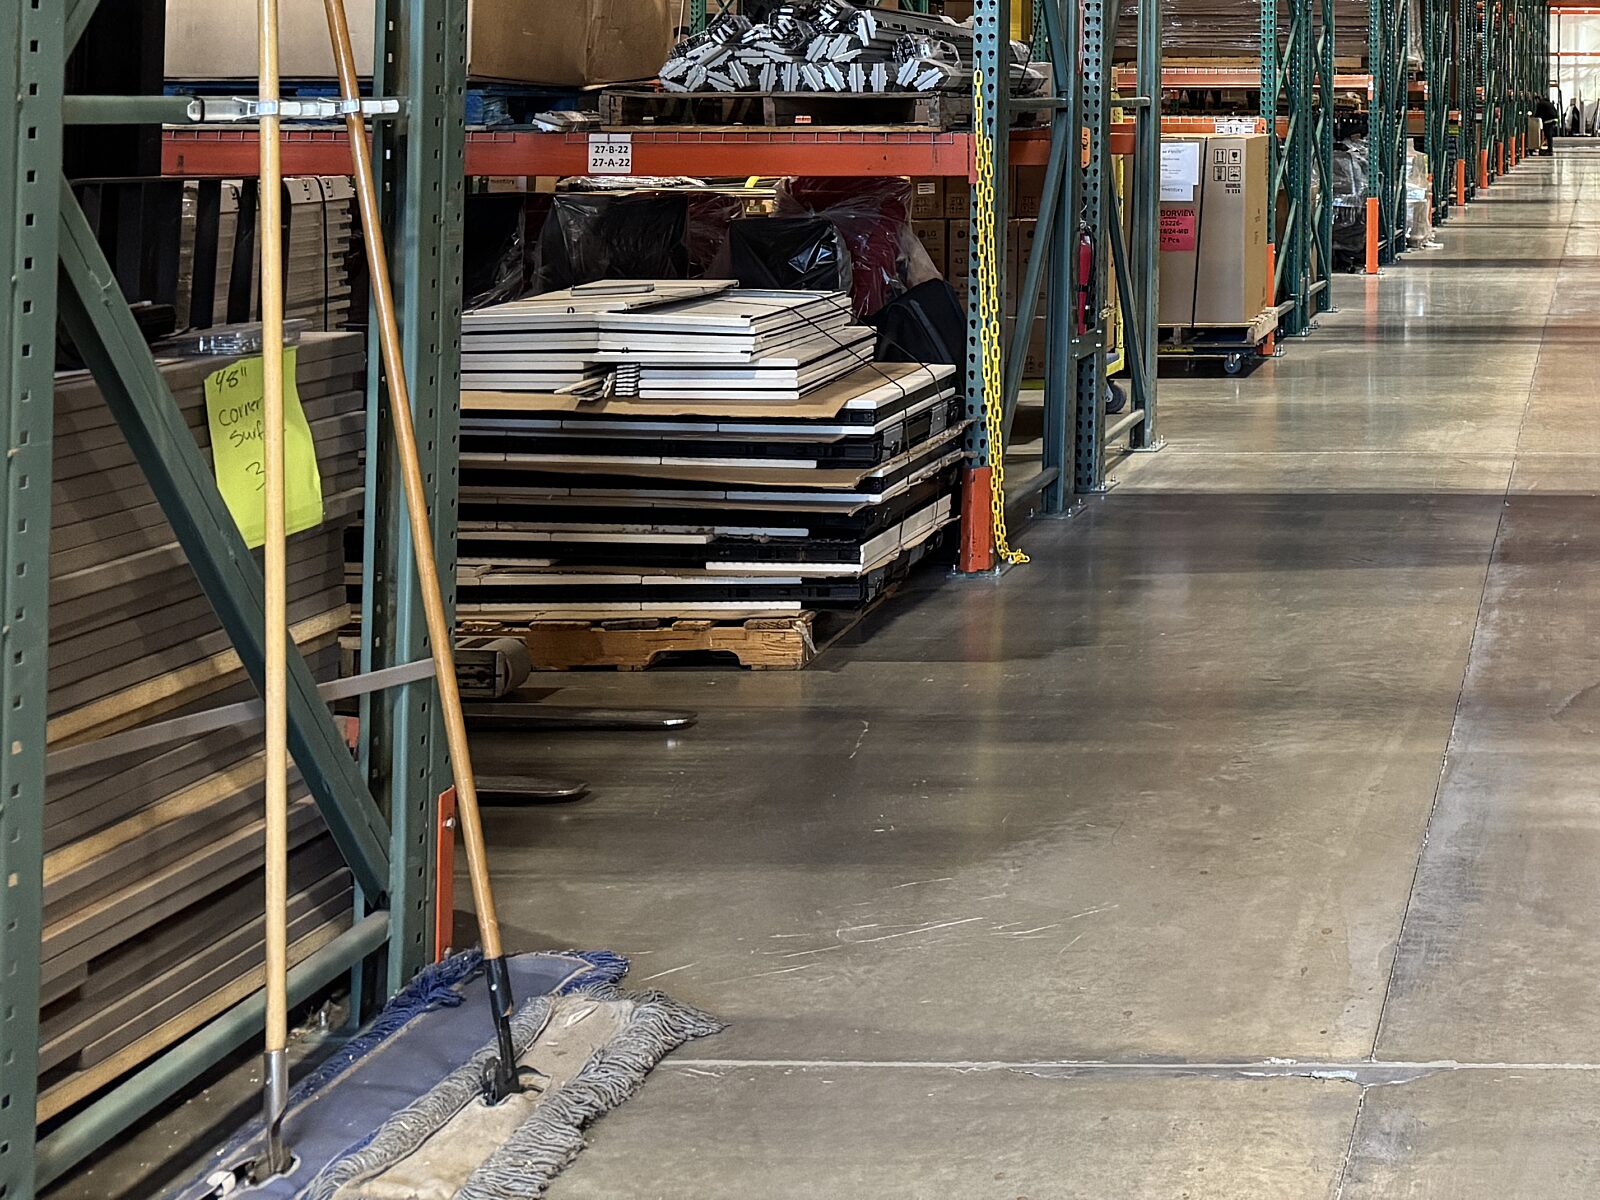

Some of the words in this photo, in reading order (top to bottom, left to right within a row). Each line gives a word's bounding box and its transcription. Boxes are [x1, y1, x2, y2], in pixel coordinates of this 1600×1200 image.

[594, 145, 629, 154] 27-B-22
[592, 158, 630, 167] 27-A-22
[1160, 209, 1195, 217] BORVIEW
[215, 366, 248, 393] 48"
[229, 421, 268, 448] surf
